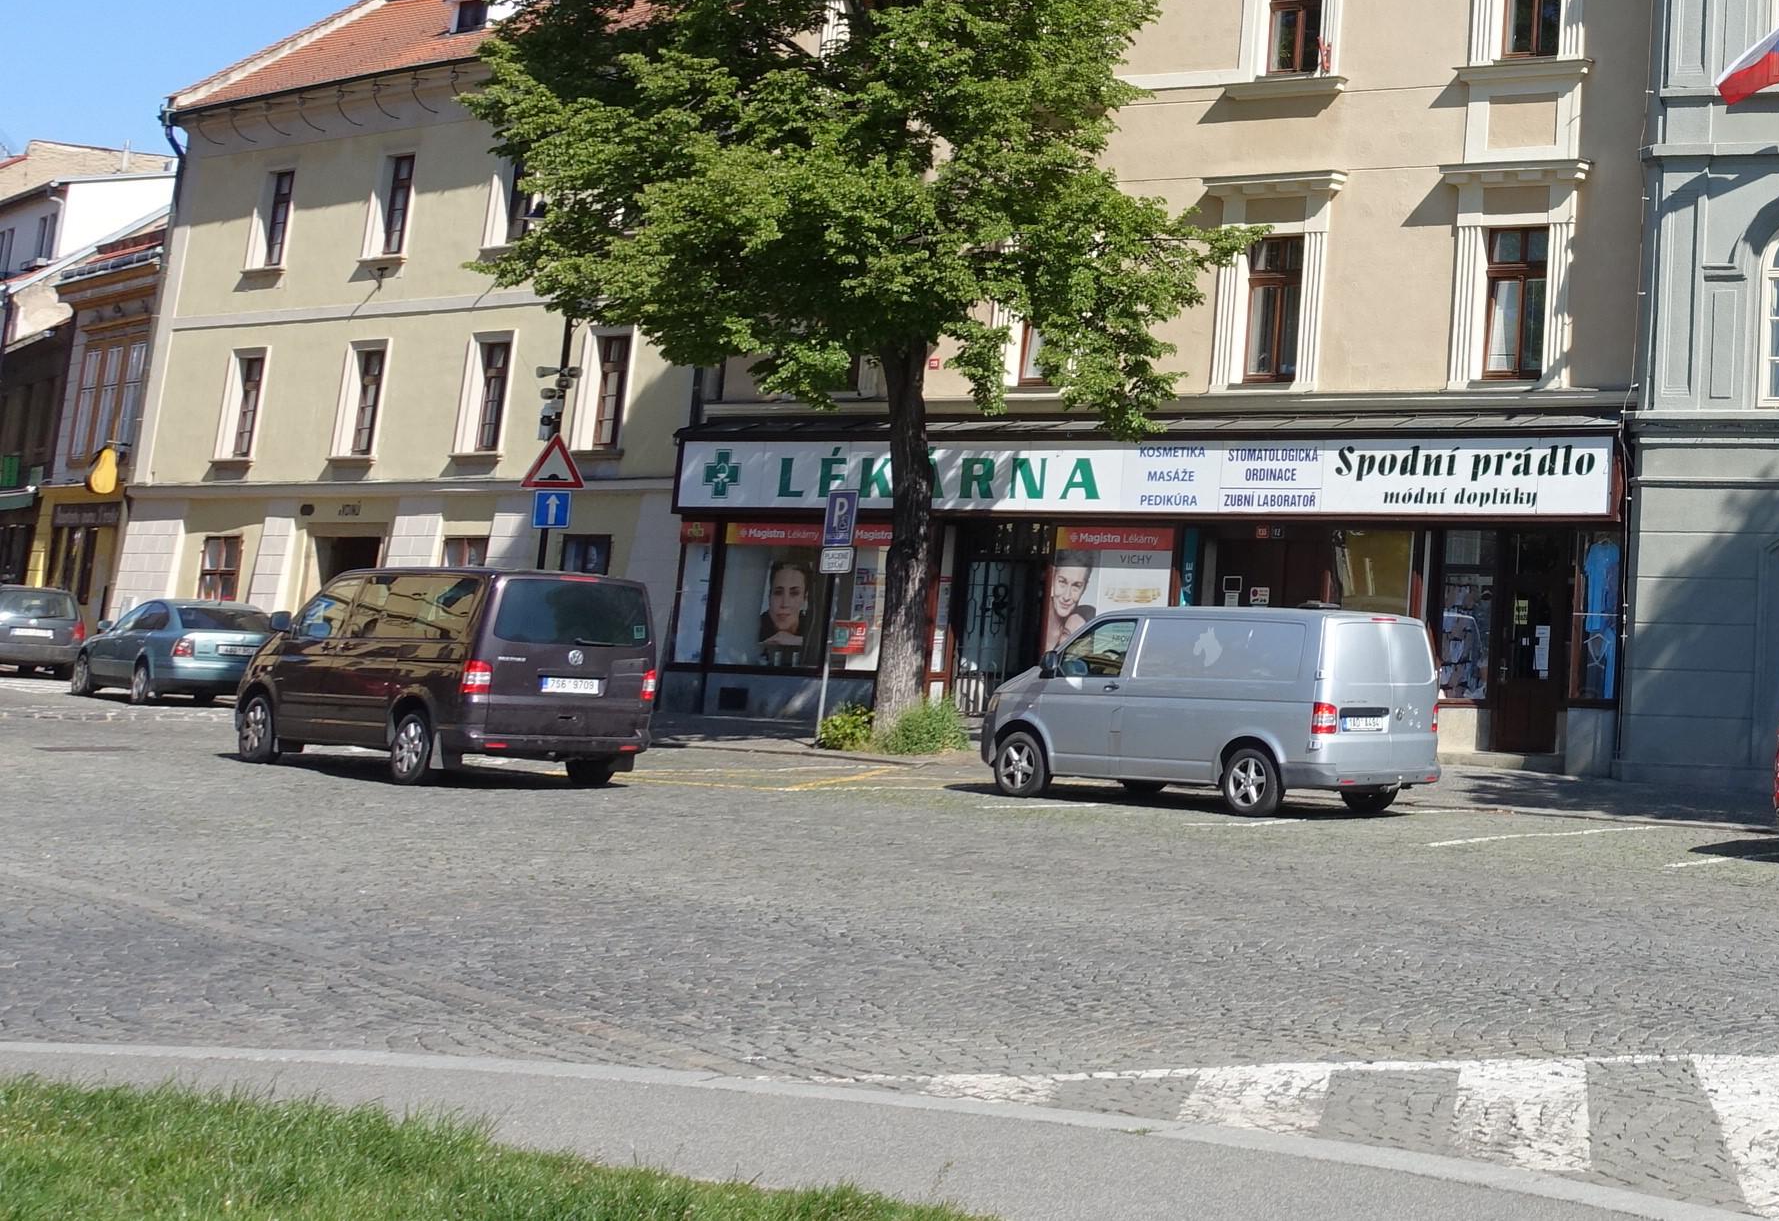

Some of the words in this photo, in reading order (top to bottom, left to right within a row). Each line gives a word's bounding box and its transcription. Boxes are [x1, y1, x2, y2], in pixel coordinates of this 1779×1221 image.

[1139, 446, 1206, 458] KOSMETIKA
[1227, 447, 1319, 462] STOMATOLOGICKÁ
[1335, 445, 1460, 482] Spodní
[1470, 445, 1596, 482] prádlo
[1147, 468, 1195, 482] MASÁŽE
[1245, 468, 1297, 482] ORDINACE
[1140, 492, 1198, 506] PEDIKÚRA
[1224, 491, 1255, 507] ZUBNÍ
[1257, 492, 1316, 507] LABORATOŘ
[1383, 487, 1448, 505] módní
[1454, 487, 1538, 508] doplňky
[748, 529, 785, 539] Magistra
[855, 530, 893, 540] Magistra
[1079, 533, 1121, 544] Magistra
[1123, 534, 1160, 545] Lékárny
[1120, 555, 1152, 564] VICHY
